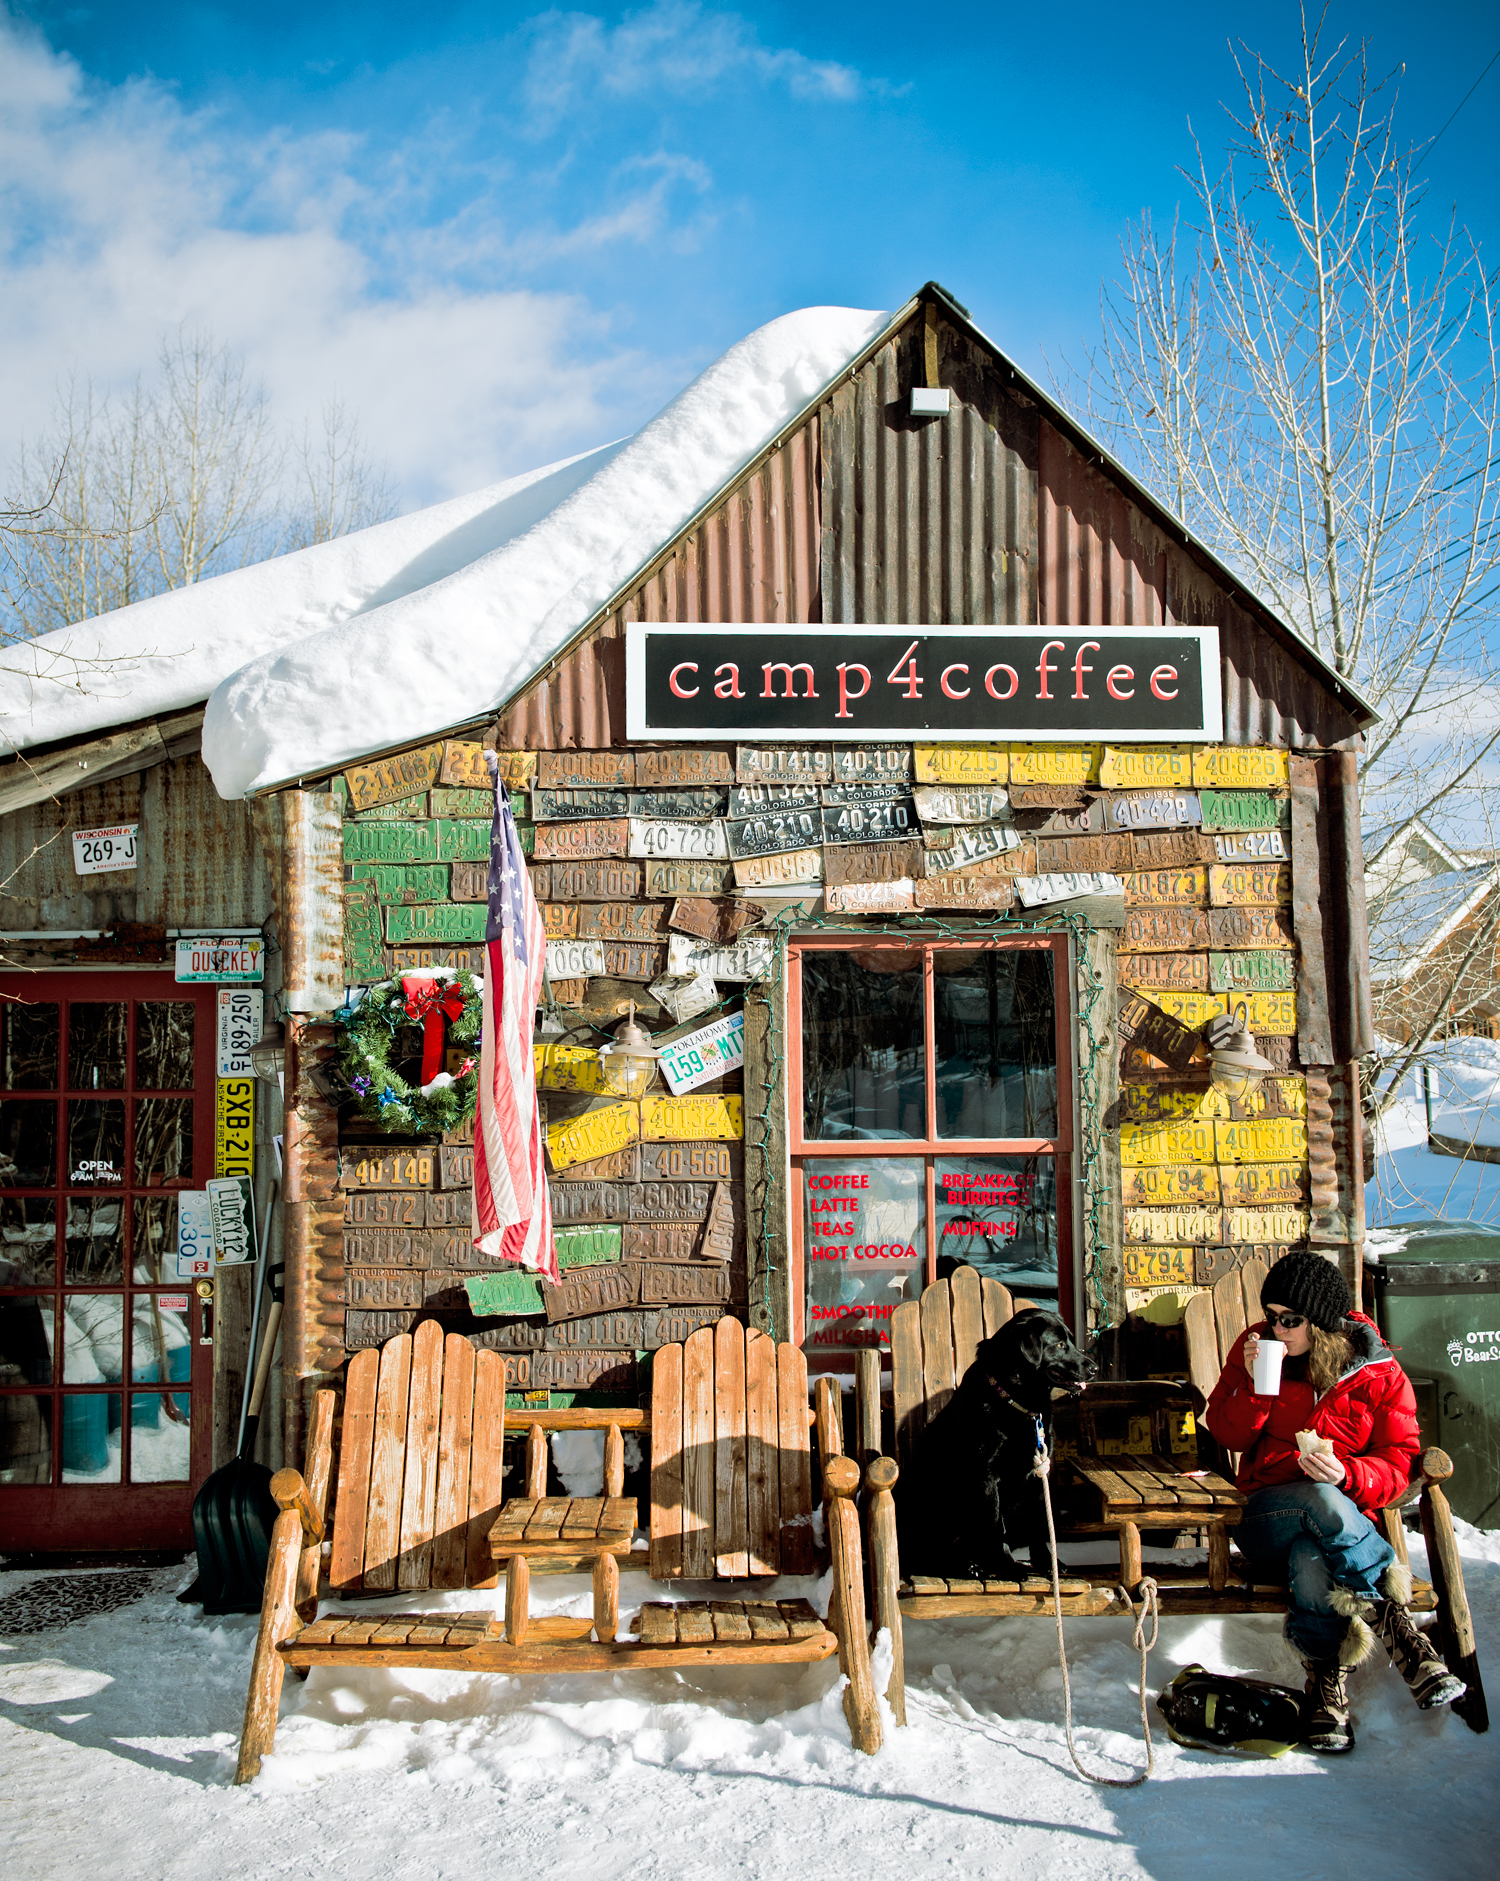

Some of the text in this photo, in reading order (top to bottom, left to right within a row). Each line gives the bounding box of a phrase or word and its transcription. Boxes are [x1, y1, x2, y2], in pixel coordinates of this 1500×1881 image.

[668, 640, 1179, 718] camp4coffee
[371, 752, 421, 771] COLORFUL
[550, 751, 629, 776] 40T564
[645, 751, 729, 775] 40-1340
[748, 750, 828, 773] 40T419
[841, 750, 911, 772] 40-107
[928, 750, 998, 772] 40-215
[1023, 750, 1093, 773] 40-515
[1113, 754, 1182, 776] 40-826
[1206, 754, 1276, 776] 40-826
[564, 775, 618, 784] COLORADO
[661, 772, 713, 781] COLORADO
[762, 772, 814, 781] COLORADO
[859, 771, 911, 780] COLORADO
[939, 772, 990, 780] COLORADO
[1034, 773, 1085, 781] COLORADO
[1122, 776, 1173, 784] COLORADO
[1216, 776, 1268, 784] COLORADO
[378, 779, 430, 800] COLORADO
[846, 788, 899, 801] COLORADO
[754, 798, 805, 812] COLORADO
[846, 801, 897, 810] COLORFUL
[1116, 797, 1189, 824] 40-428
[361, 821, 415, 829] COLORFUL
[654, 818, 707, 827] COLORADO
[837, 806, 908, 832] 40-210
[1224, 820, 1275, 829] COLORADO
[75, 827, 123, 840] WISCONSIN
[742, 813, 814, 845] 40-210
[848, 830, 899, 840] COLORADO
[345, 828, 430, 852] 40T320
[643, 827, 717, 854] 40-728
[753, 838, 806, 852] COLORADO
[360, 851, 414, 860] COLORADO
[556, 847, 610, 856] COLORADO
[96, 861, 121, 870] America's
[578, 861, 629, 870] COLORADO
[749, 850, 821, 884] 40-961
[1126, 872, 1197, 895] 40-873
[1222, 871, 1292, 895] 40-873
[851, 900, 906, 910] COLORADO
[1136, 895, 1188, 903] COLORADO
[401, 907, 475, 931] 40-826
[1134, 910, 1184, 918] COLORFUL
[410, 930, 465, 938] COLORADO
[604, 928, 657, 938] COLORADO
[180, 942, 192, 950] SEP
[1136, 939, 1188, 948] COLORADO
[1230, 937, 1281, 946] COLORADO
[1125, 956, 1205, 979] 40T720
[1140, 979, 1192, 987] COLORADO
[1233, 979, 1285, 988] COLORADO
[230, 994, 252, 1058] 189-250
[252, 1017, 260, 1044] RAILER
[1119, 998, 1186, 1054] 40-870
[677, 1023, 727, 1051] OKLAHOMA
[668, 1050, 705, 1083] 159
[695, 1067, 716, 1083] NATIVE
[665, 1097, 719, 1105] COLORFUL
[566, 1108, 618, 1129] COLORFUL
[650, 1104, 732, 1129] 40T324
[1238, 1119, 1290, 1127] COLORFUL
[217, 1124, 225, 1148] FIRST
[555, 1109, 633, 1155] 40T327
[665, 1128, 718, 1137] COLORADO
[1225, 1125, 1304, 1150] 40T318
[574, 1136, 627, 1158] COLORADO
[1128, 1128, 1207, 1155] 40T320
[1142, 1152, 1194, 1161] COLORADO
[1240, 1149, 1291, 1158] COLORADO
[78, 1160, 114, 1171] OPEN
[217, 1150, 225, 1179] STATE
[355, 1157, 431, 1184] 40-148
[656, 1149, 730, 1176] 40-560
[808, 1174, 870, 1190] COFFEE
[942, 1173, 1036, 1189] BREAKFAST
[1133, 1169, 1206, 1193] 40-794
[947, 1190, 1031, 1206] BURRITOS
[1145, 1192, 1197, 1201] COLORADO
[1245, 1191, 1297, 1200] COLORADO
[811, 1197, 859, 1213] LATTE
[212, 1203, 222, 1244] COLORADO
[811, 1221, 855, 1236] TEAS
[942, 1221, 1017, 1237] MUFFINS
[180, 1211, 198, 1258] 630
[812, 1243, 918, 1261] HOT COCOA
[196, 1262, 203, 1272] 04
[1124, 1274, 1177, 1284] COLORADO
[1149, 1286, 1199, 1297] COLORADO
[552, 1317, 641, 1344] 40-1184
[1463, 1345, 1500, 1363] BearS
[534, 1390, 547, 1400] 52
